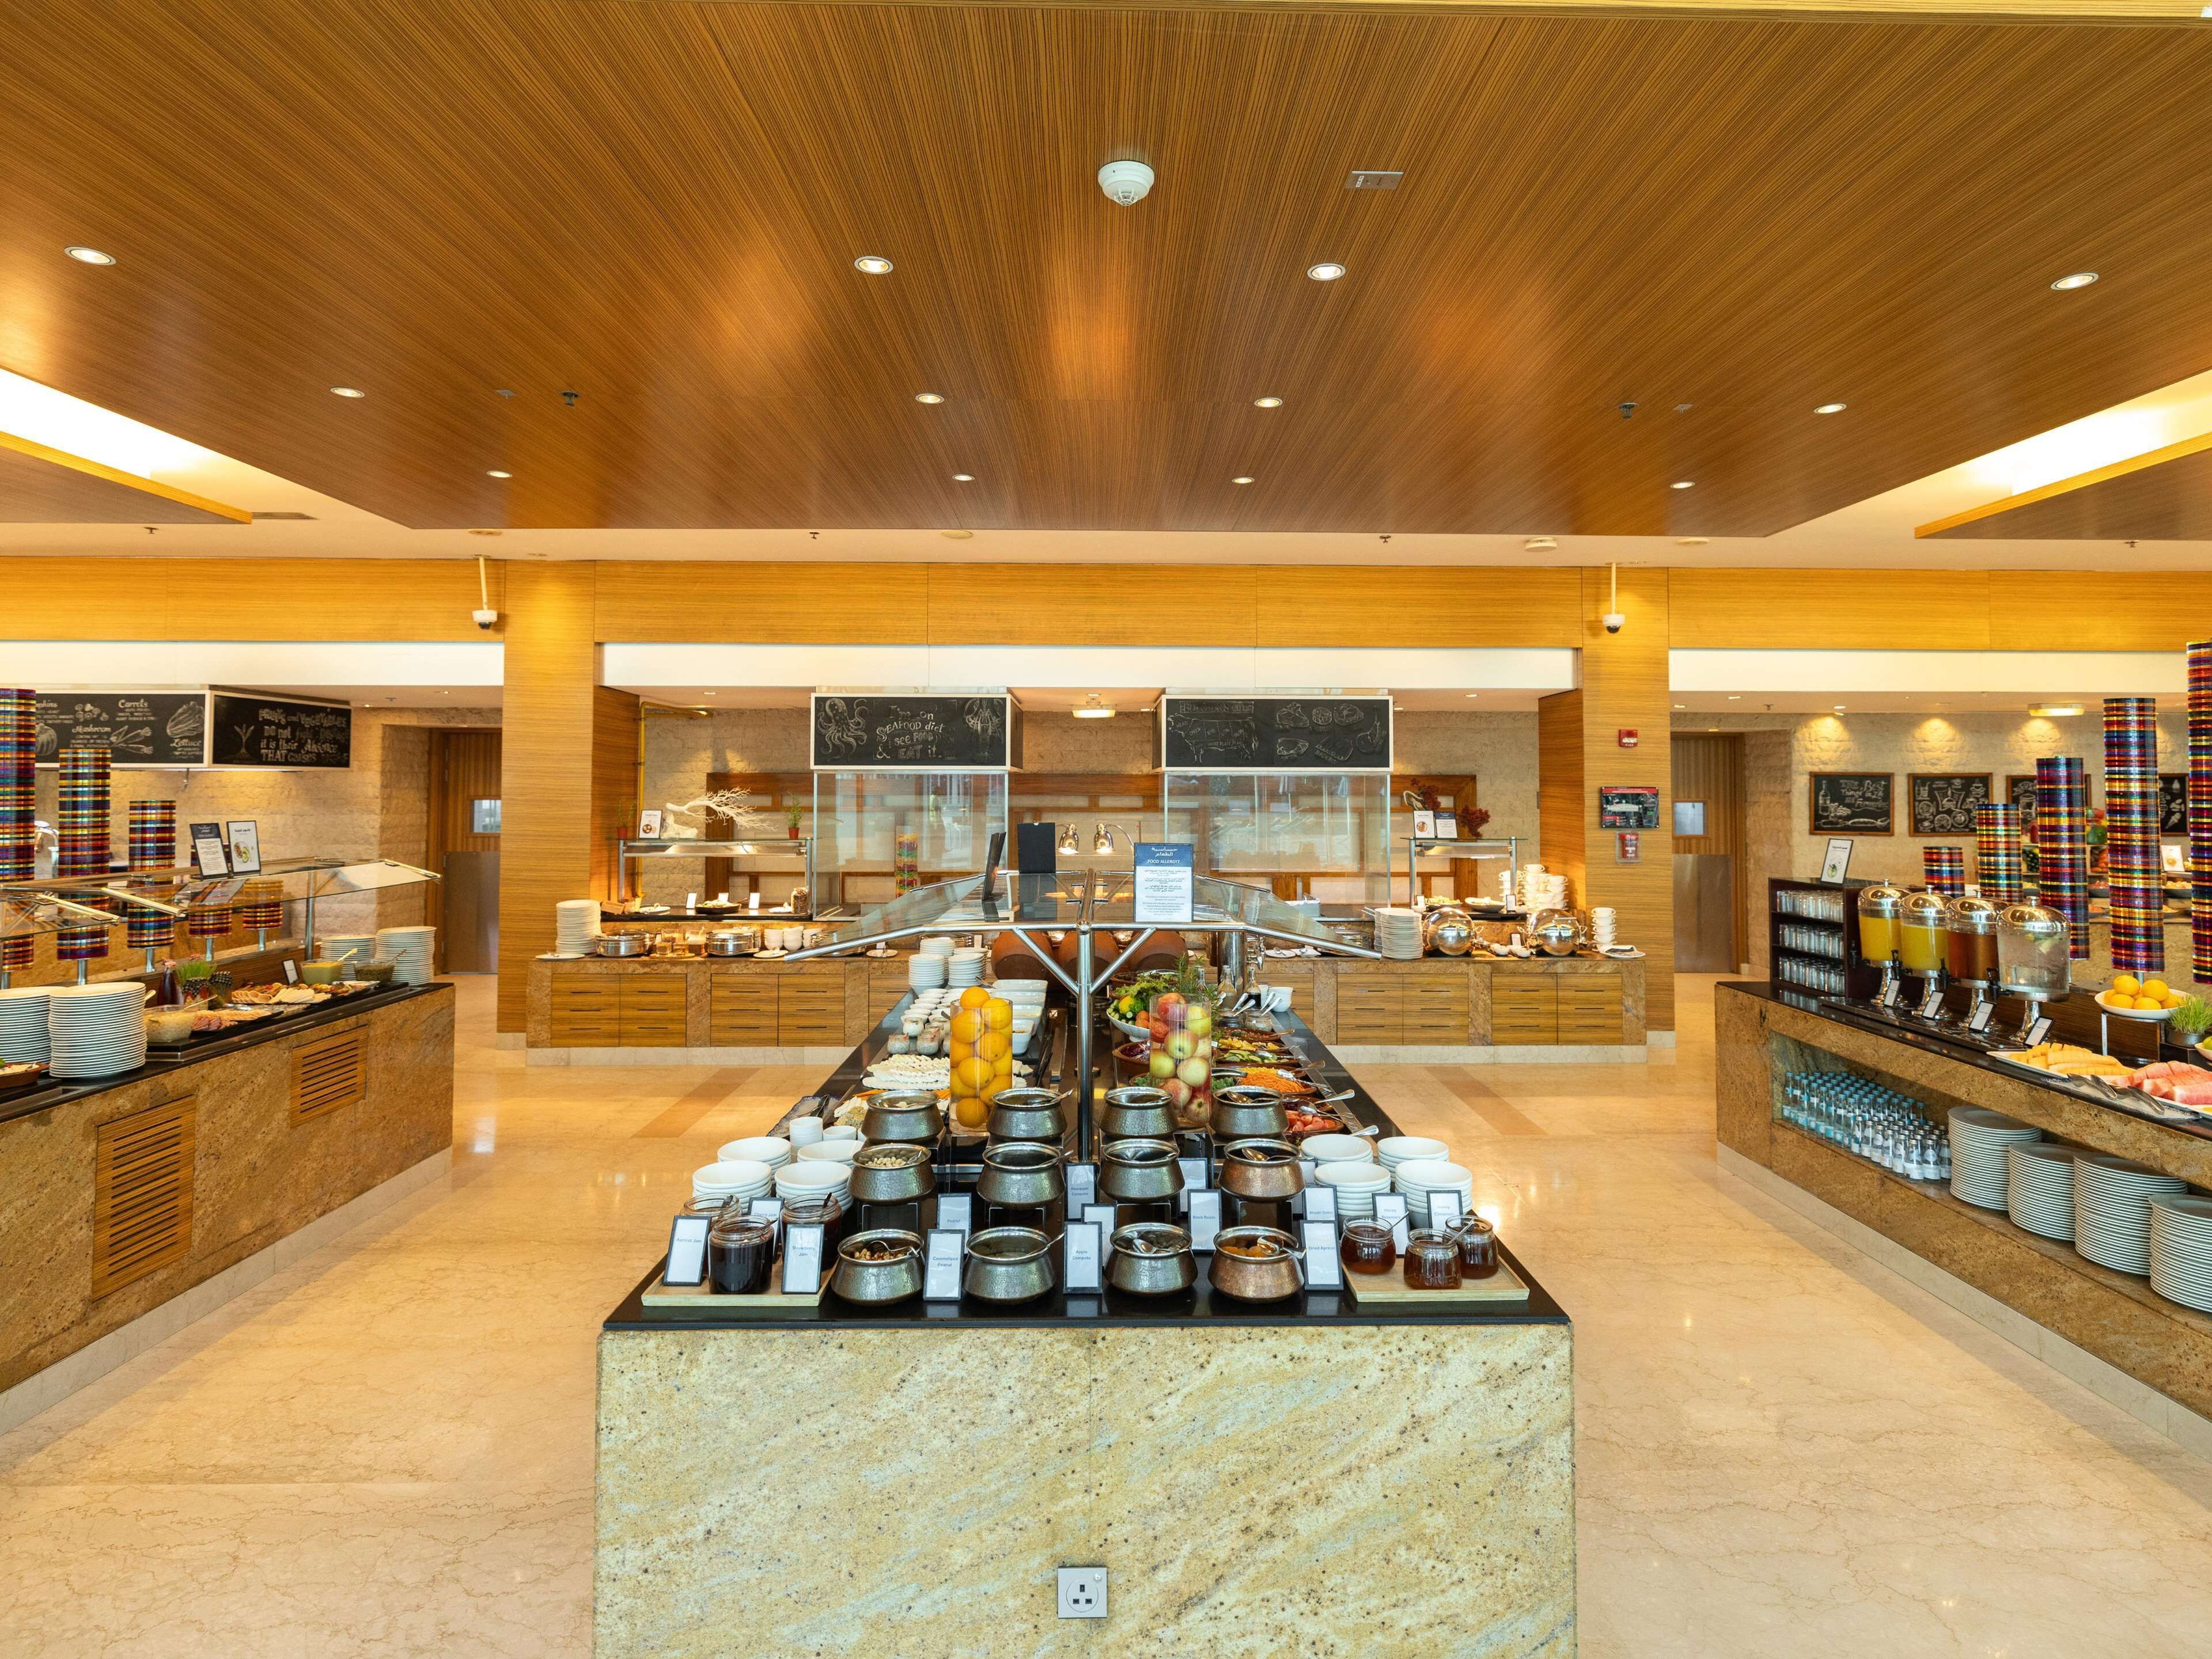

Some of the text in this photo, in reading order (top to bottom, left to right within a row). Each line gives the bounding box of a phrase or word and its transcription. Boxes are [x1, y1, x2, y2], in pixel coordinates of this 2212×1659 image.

[118, 698, 149, 708] Carrots
[889, 705, 934, 720] I'm on
[876, 721, 945, 742] SEAFOOD diet
[893, 735, 911, 746] see
[913, 732, 934, 742] FOOD
[260, 749, 288, 762] THAT
[898, 744, 923, 759] EAT
